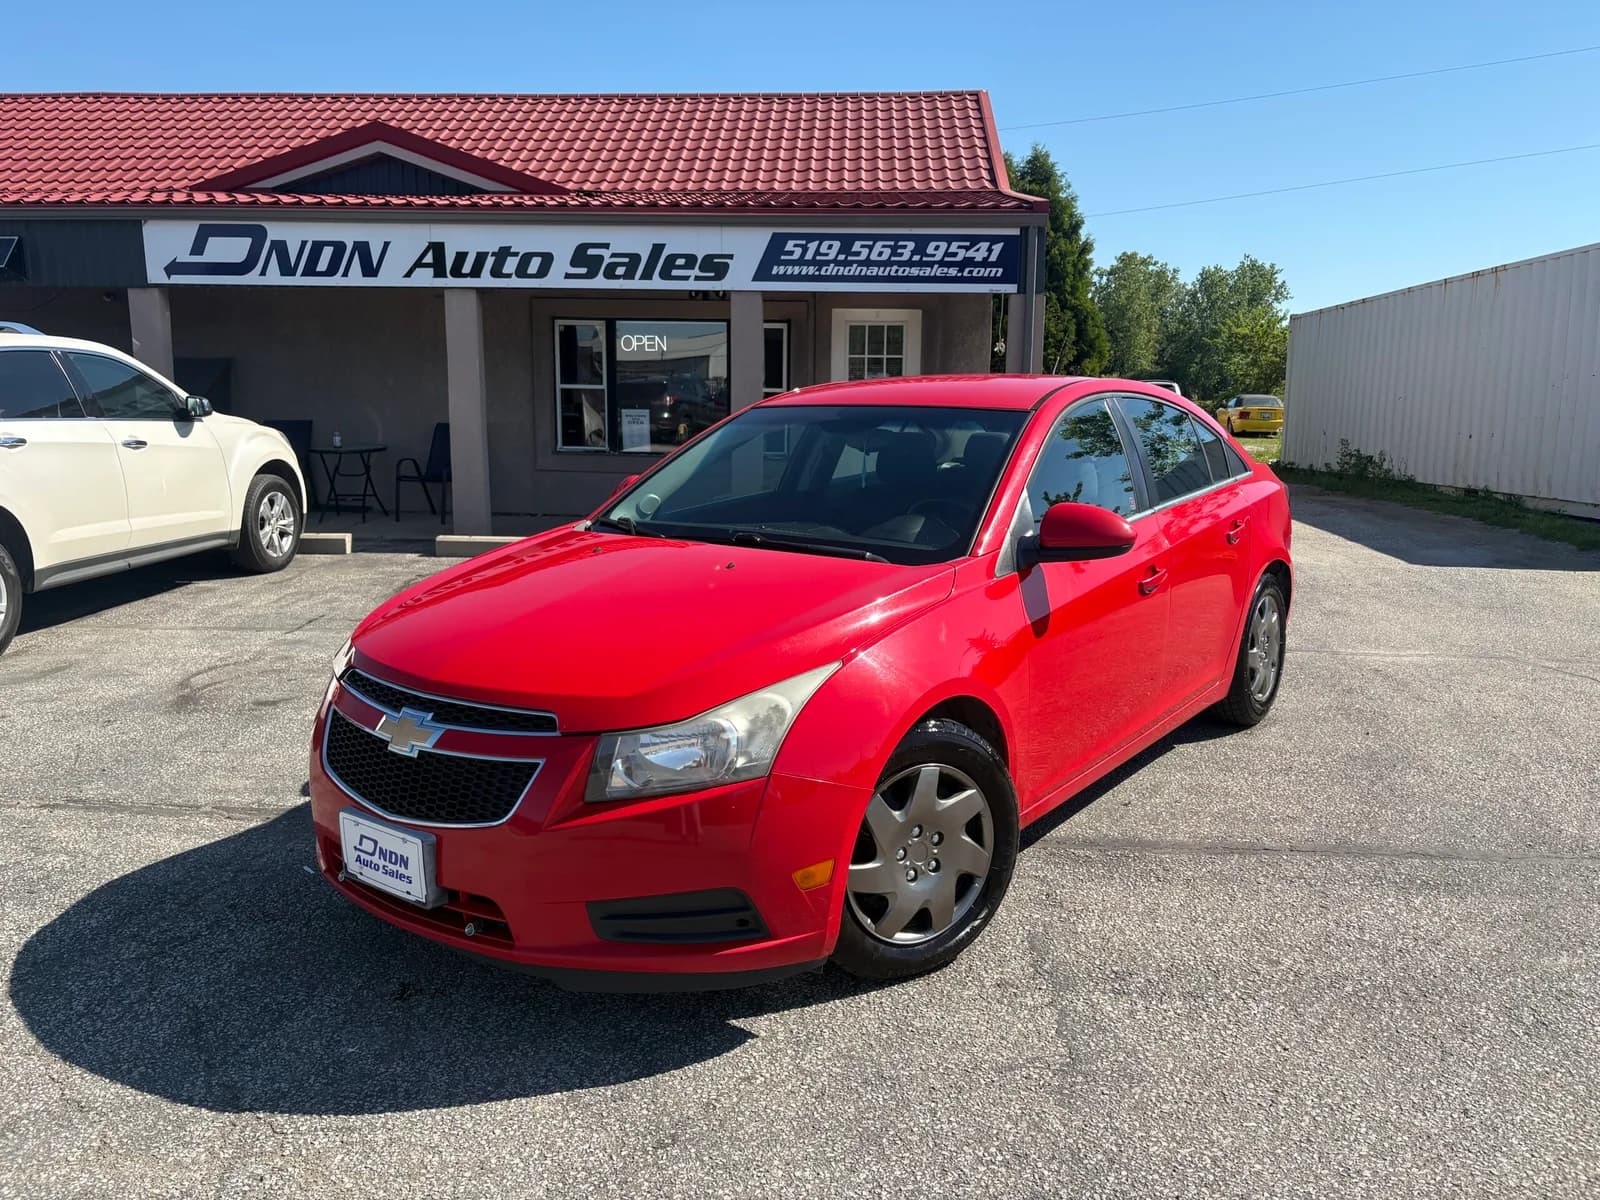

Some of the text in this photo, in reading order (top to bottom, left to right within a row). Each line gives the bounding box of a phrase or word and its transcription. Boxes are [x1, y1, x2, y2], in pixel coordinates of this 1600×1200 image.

[163, 224, 734, 282] DNDN Auto Sales
[780, 239, 1004, 263] 519.563.9541
[771, 263, 1003, 278] www.dndnautosales.com
[620, 334, 667, 352] OPEN
[353, 834, 409, 870] DNDN
[355, 854, 413, 884] Auto Sales
